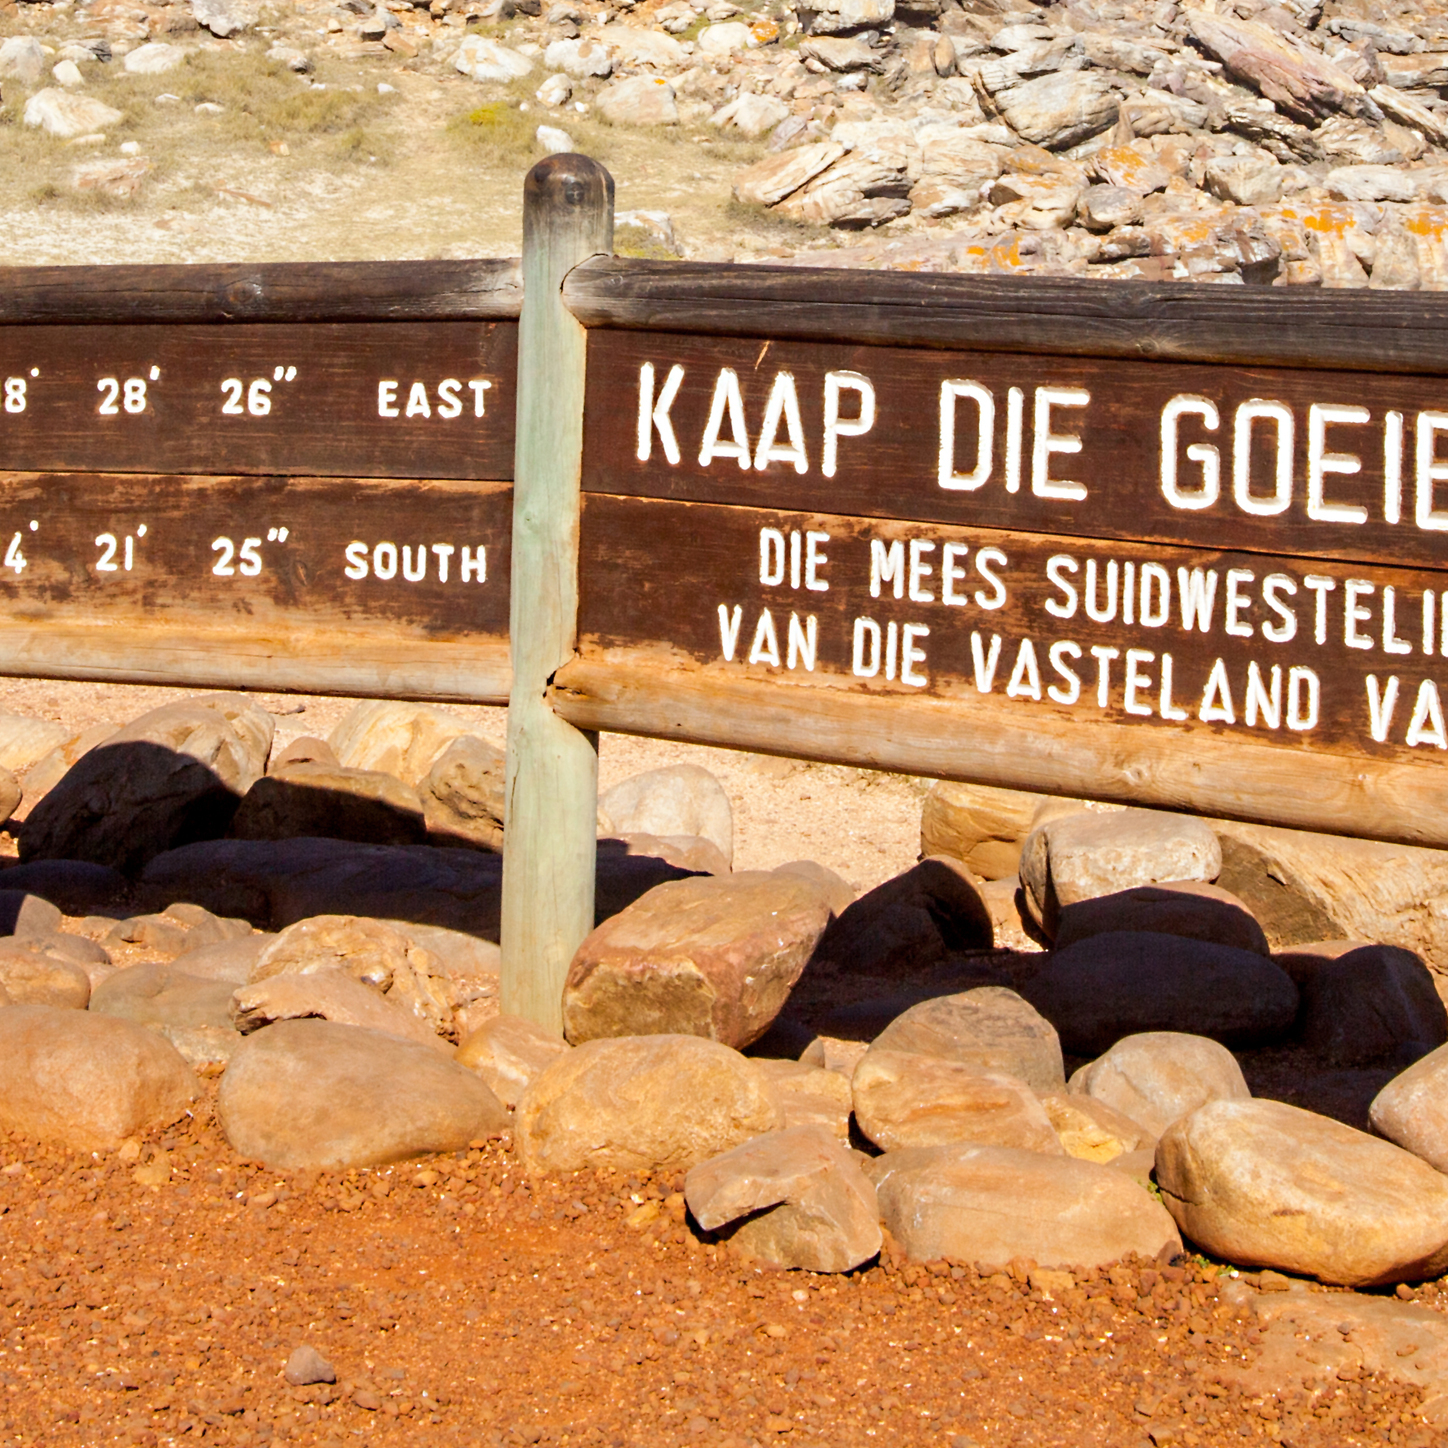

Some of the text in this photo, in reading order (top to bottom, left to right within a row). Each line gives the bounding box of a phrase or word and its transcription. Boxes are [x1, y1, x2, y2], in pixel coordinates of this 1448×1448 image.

[377, 378, 492, 419] EAST
[636, 361, 876, 478] KAAP
[937, 378, 1091, 502] DIE
[344, 542, 487, 584] SOUTH
[759, 527, 831, 592] DIE
[869, 538, 1008, 611] MEES
[717, 604, 818, 673] VAN
[852, 615, 931, 688] DIE
[970, 631, 1320, 732] VASTELAND
